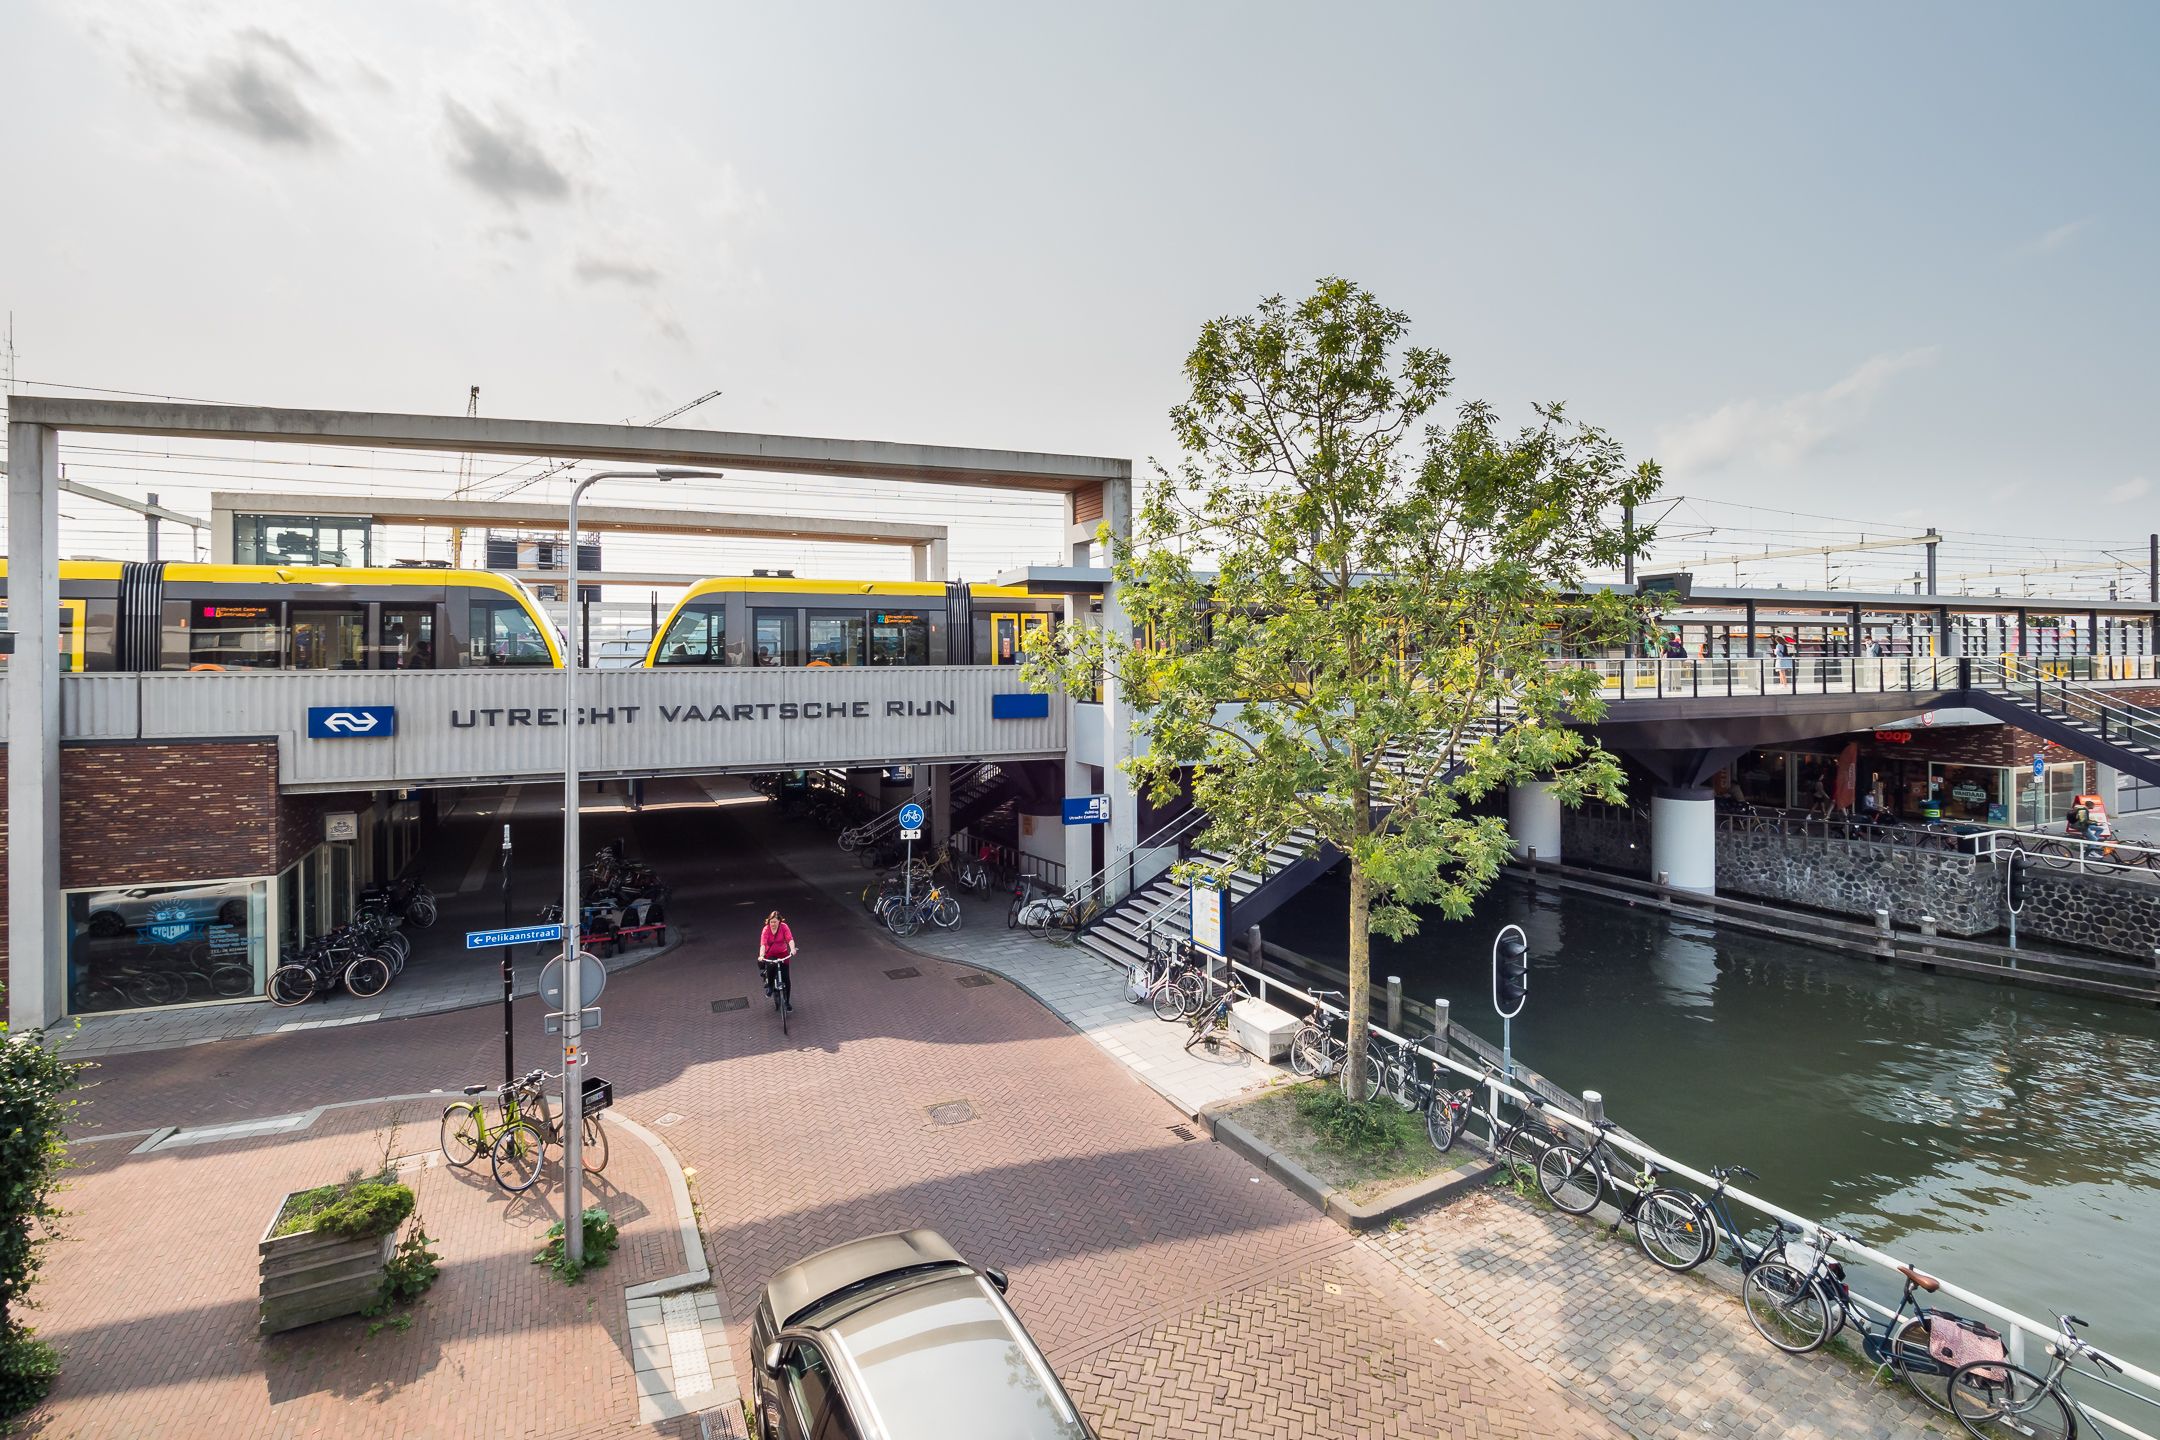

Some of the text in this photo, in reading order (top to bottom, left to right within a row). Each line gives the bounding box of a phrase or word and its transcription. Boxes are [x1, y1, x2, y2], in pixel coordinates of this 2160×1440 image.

[452, 699, 955, 728] UTRECHT VAARTSCHE RIJN
[1875, 731, 1912, 744] coop
[152, 924, 190, 940] CYCLEMAN
[485, 930, 555, 942] Pelikaanstraat
